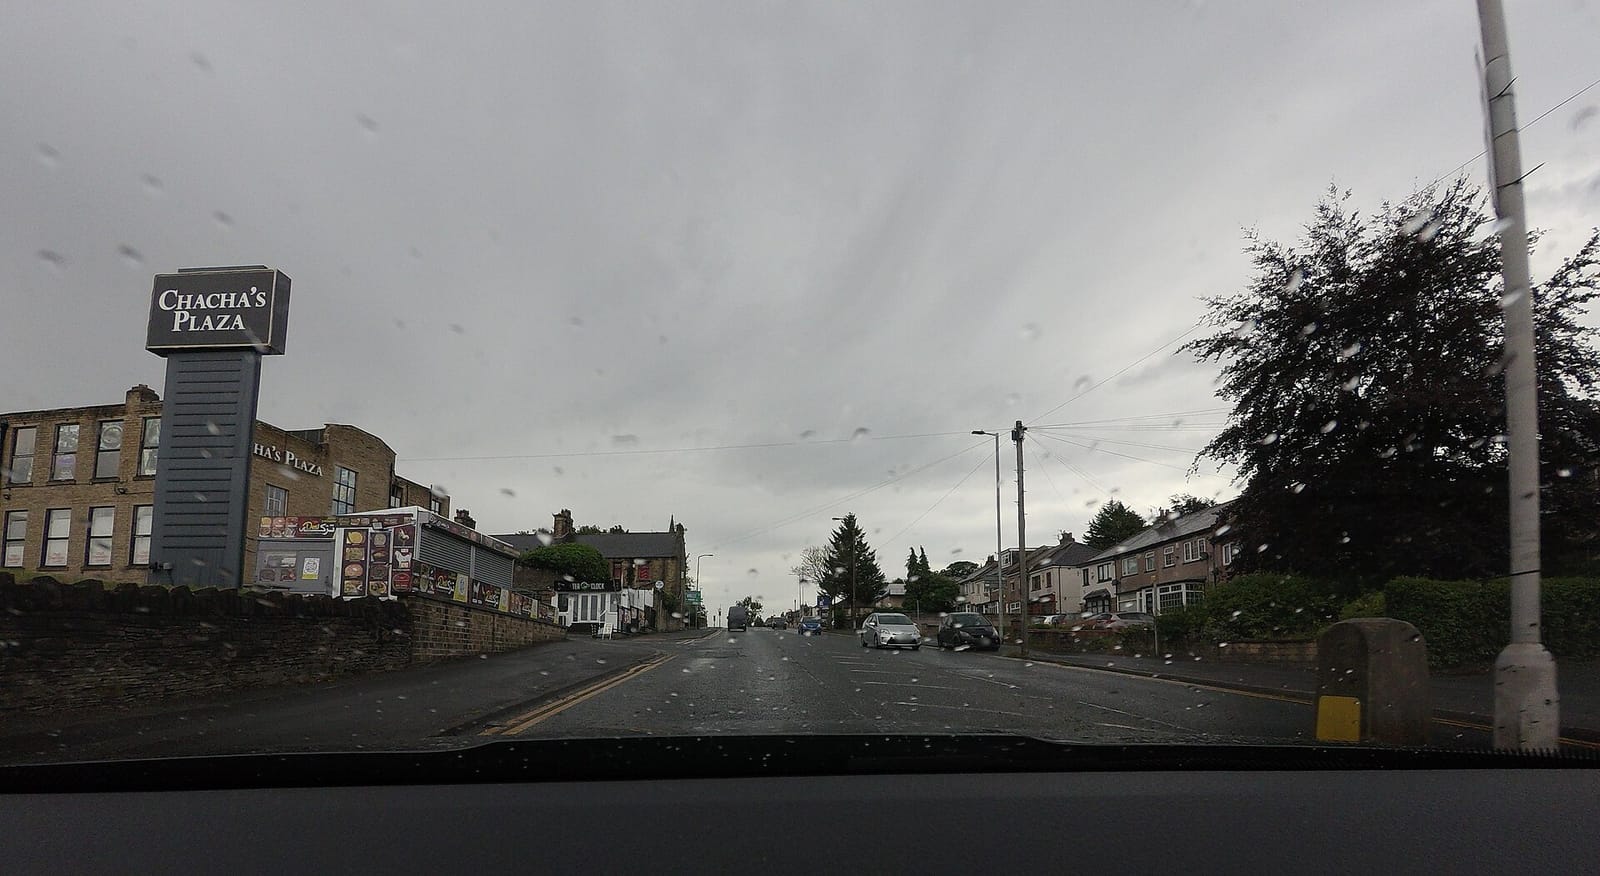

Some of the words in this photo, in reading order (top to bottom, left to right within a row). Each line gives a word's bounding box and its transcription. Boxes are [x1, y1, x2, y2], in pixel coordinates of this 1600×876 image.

[158, 287, 266, 310] CHACHA'S
[172, 310, 246, 331] PLAZA
[253, 443, 281, 462] HA'S
[284, 450, 323, 477] PLAZA
